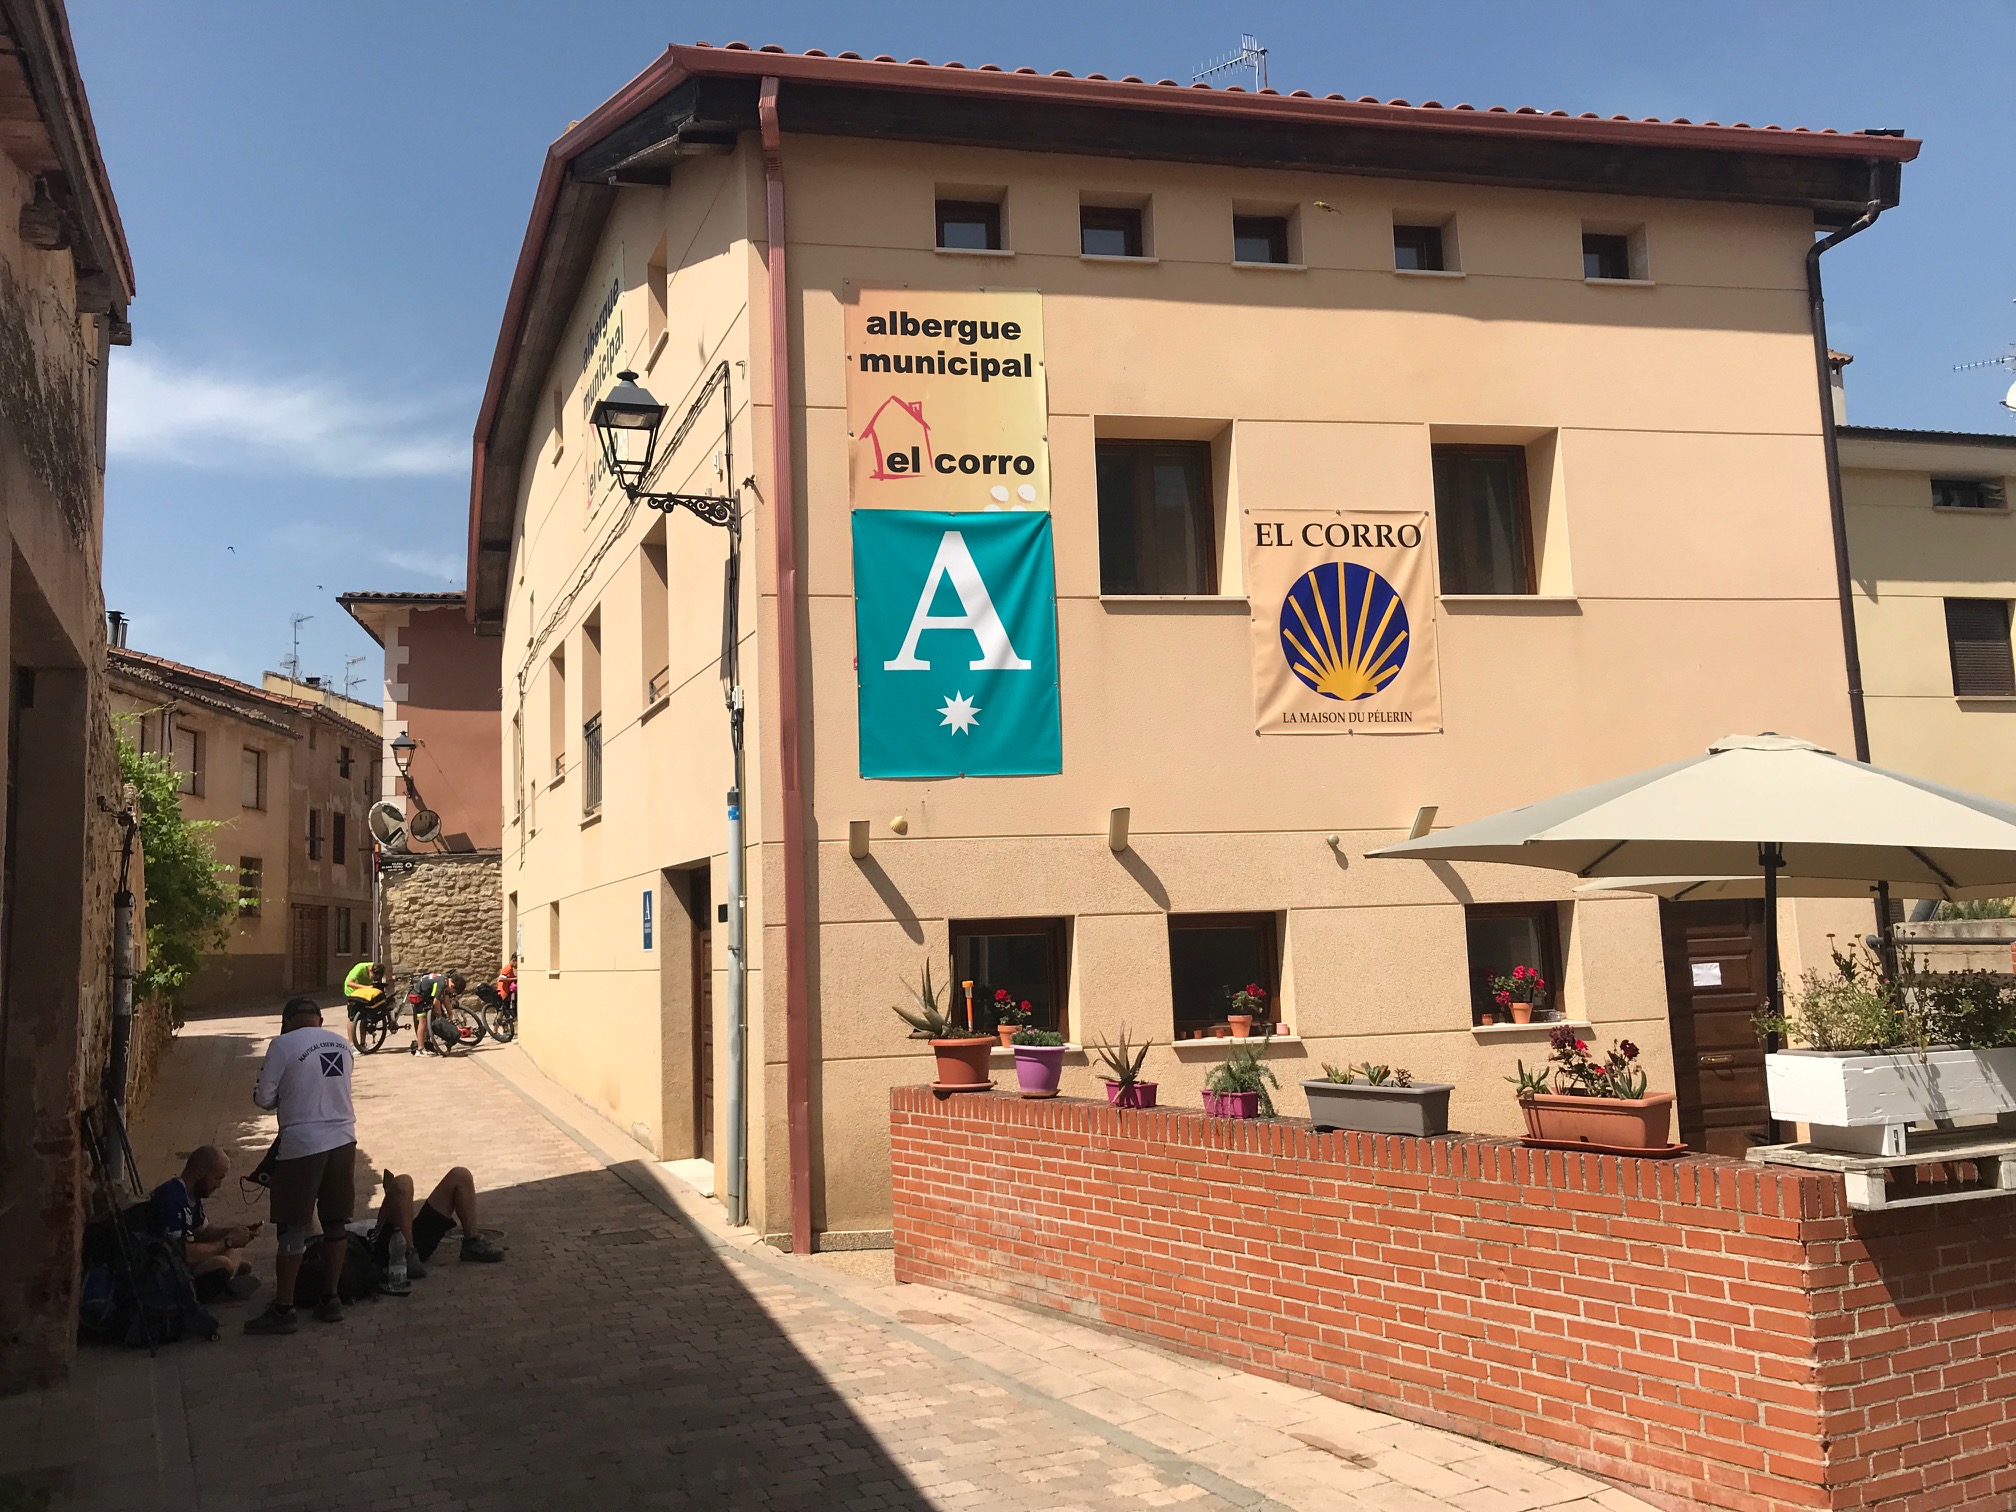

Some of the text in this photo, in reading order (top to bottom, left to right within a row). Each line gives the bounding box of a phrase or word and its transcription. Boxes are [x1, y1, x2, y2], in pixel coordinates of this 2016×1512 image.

[583, 277, 619, 374] albergue
[866, 311, 1021, 345] albergue
[583, 309, 624, 420] municipal
[860, 350, 1032, 382] municipal
[886, 446, 1035, 476] el corro
[1253, 523, 1422, 548] EL CORRO
[883, 530, 1032, 671] A
[1282, 709, 1413, 723] LA MAISON DU PÉLERIN
[298, 1044, 320, 1062] NAUTICAL
